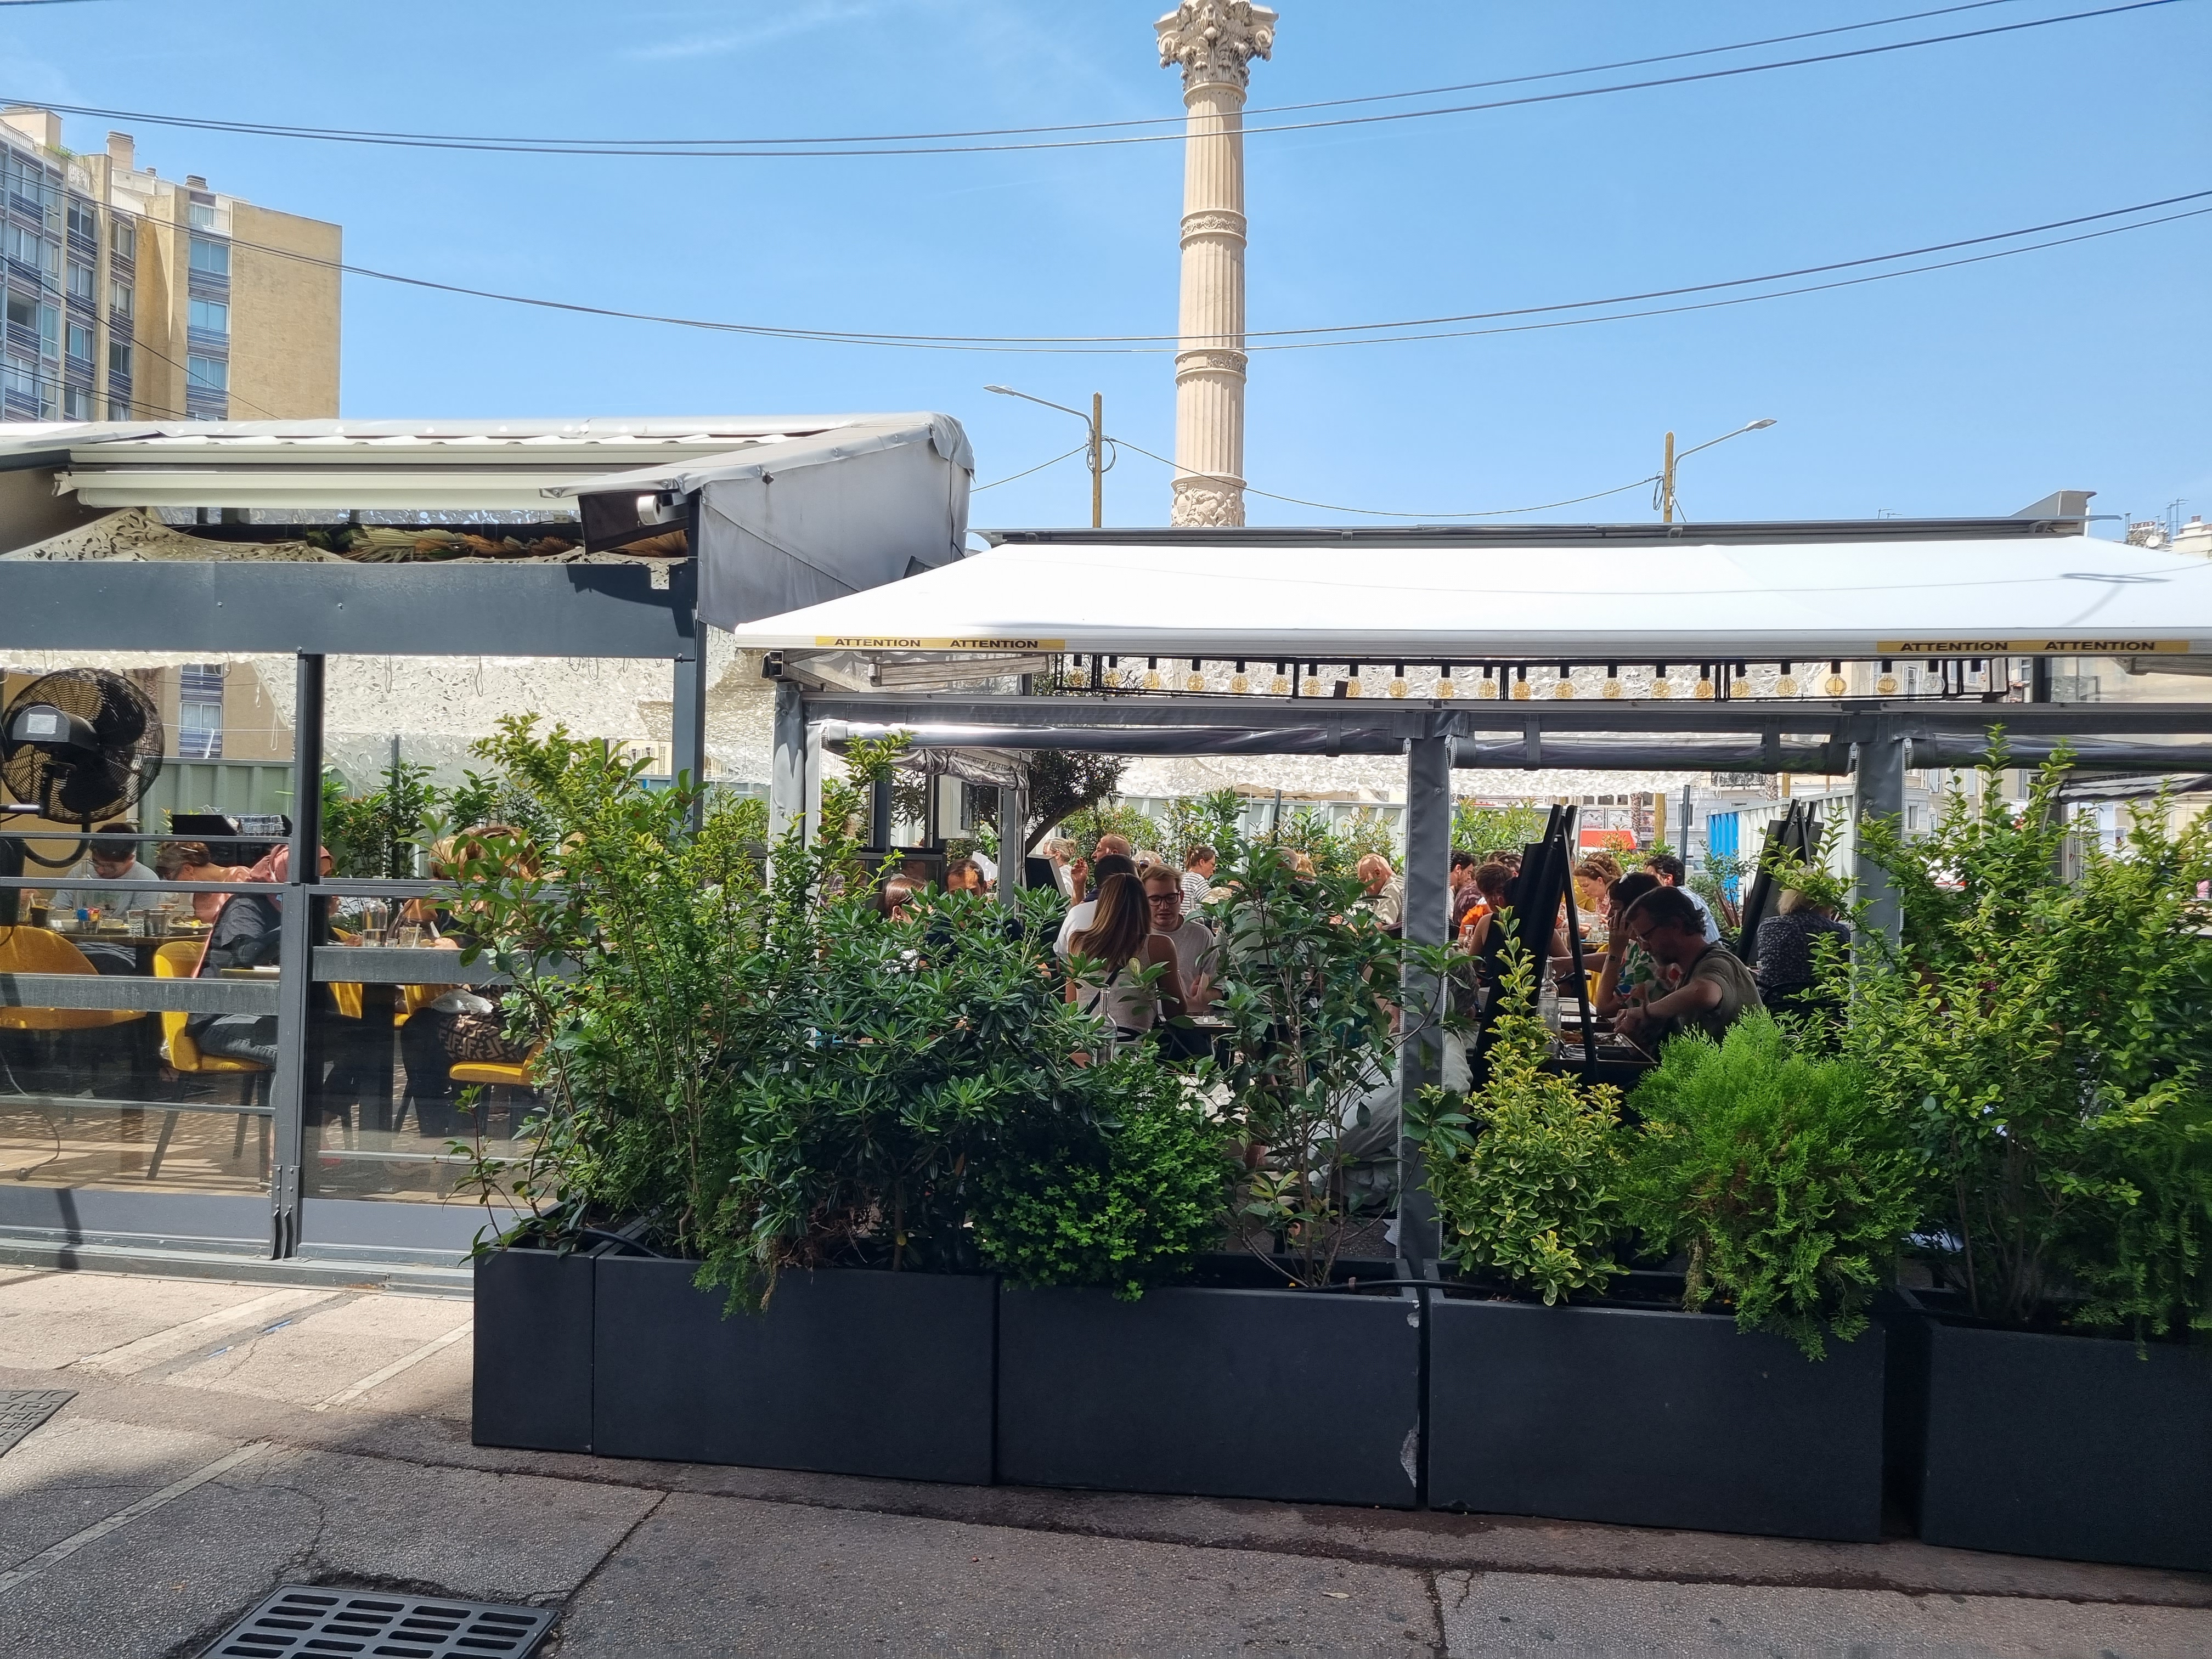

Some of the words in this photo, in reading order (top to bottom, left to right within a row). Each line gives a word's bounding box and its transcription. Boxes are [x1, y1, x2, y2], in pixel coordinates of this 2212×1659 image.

[834, 638, 921, 647] ATTENTION
[950, 640, 1038, 648] ATTENTION
[1900, 642, 2008, 651] ATTENTION
[2044, 641, 2155, 651] ATTENTION
